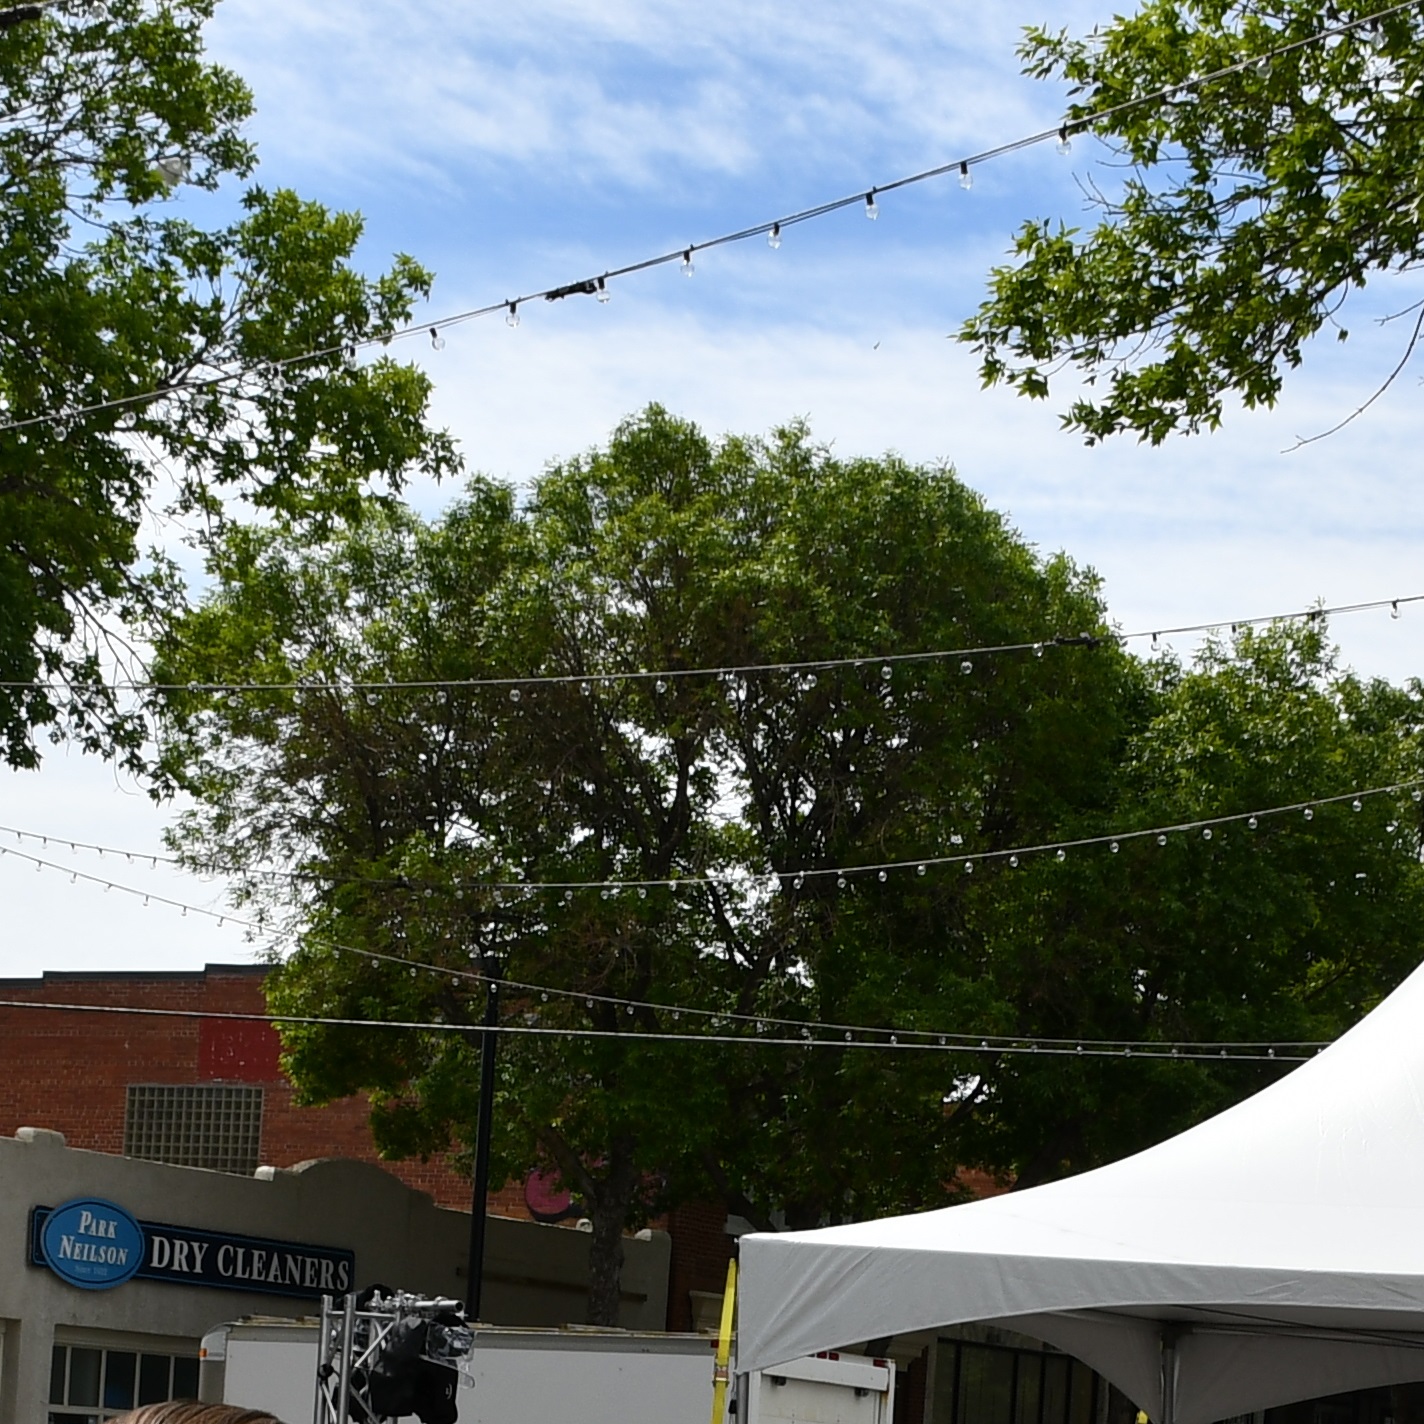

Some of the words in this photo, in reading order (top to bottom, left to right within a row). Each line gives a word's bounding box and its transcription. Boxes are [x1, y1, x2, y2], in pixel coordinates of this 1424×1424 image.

[57, 1235, 129, 1266] NEILSON
[149, 1235, 210, 1274] DRY
[216, 1244, 351, 1292] CLEANERS
